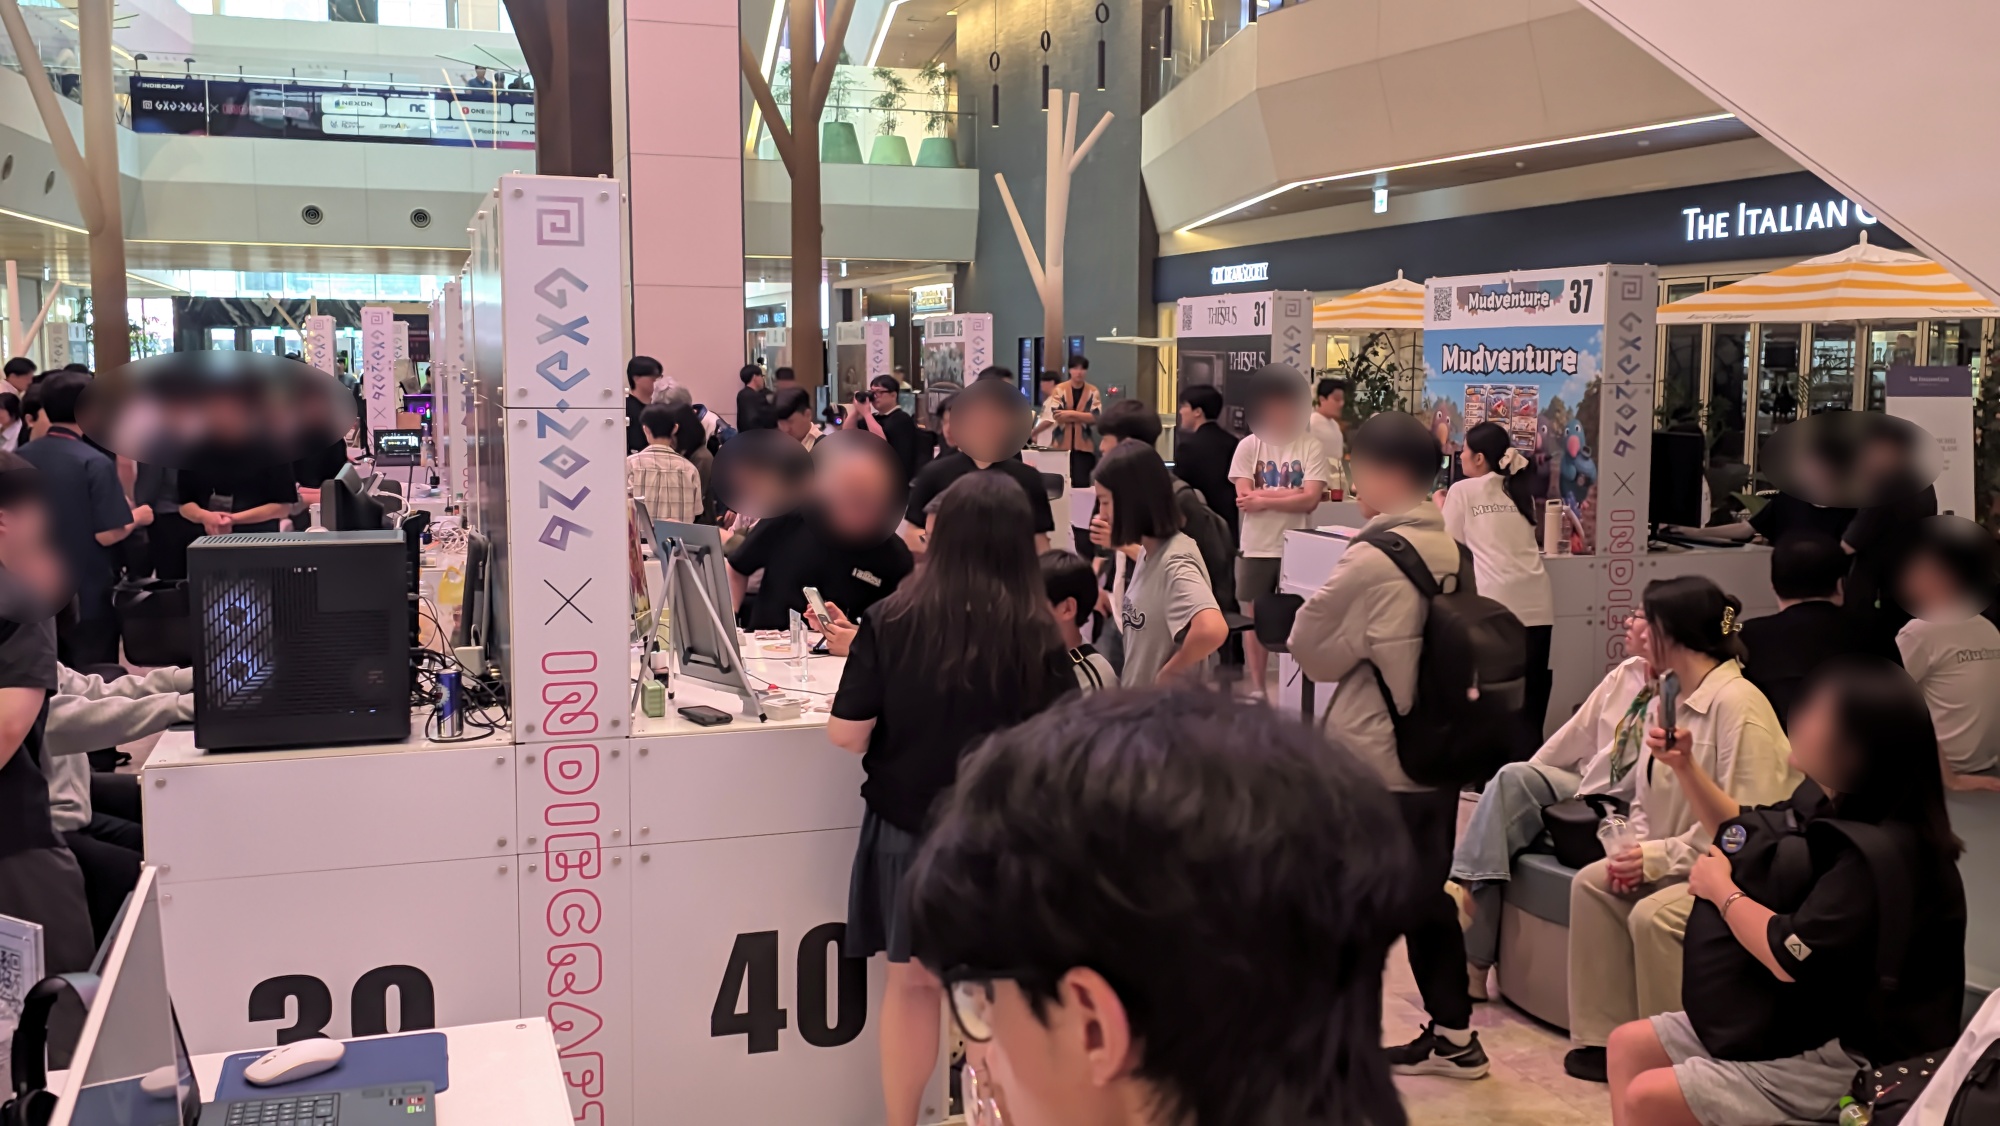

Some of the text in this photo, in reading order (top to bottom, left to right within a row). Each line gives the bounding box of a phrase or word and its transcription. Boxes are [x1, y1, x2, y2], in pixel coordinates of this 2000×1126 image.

[1683, 207, 1730, 240] THE
[1738, 199, 1848, 236] ITALIAN
[1468, 290, 1550, 312] Mudventure
[1569, 279, 1593, 314] 37
[1254, 301, 1266, 327] 31
[1442, 342, 1578, 376] Mudventure
[1472, 503, 1519, 517] Mudven
[1606, 509, 1635, 673] INDIEC
[711, 922, 867, 1054] 40
